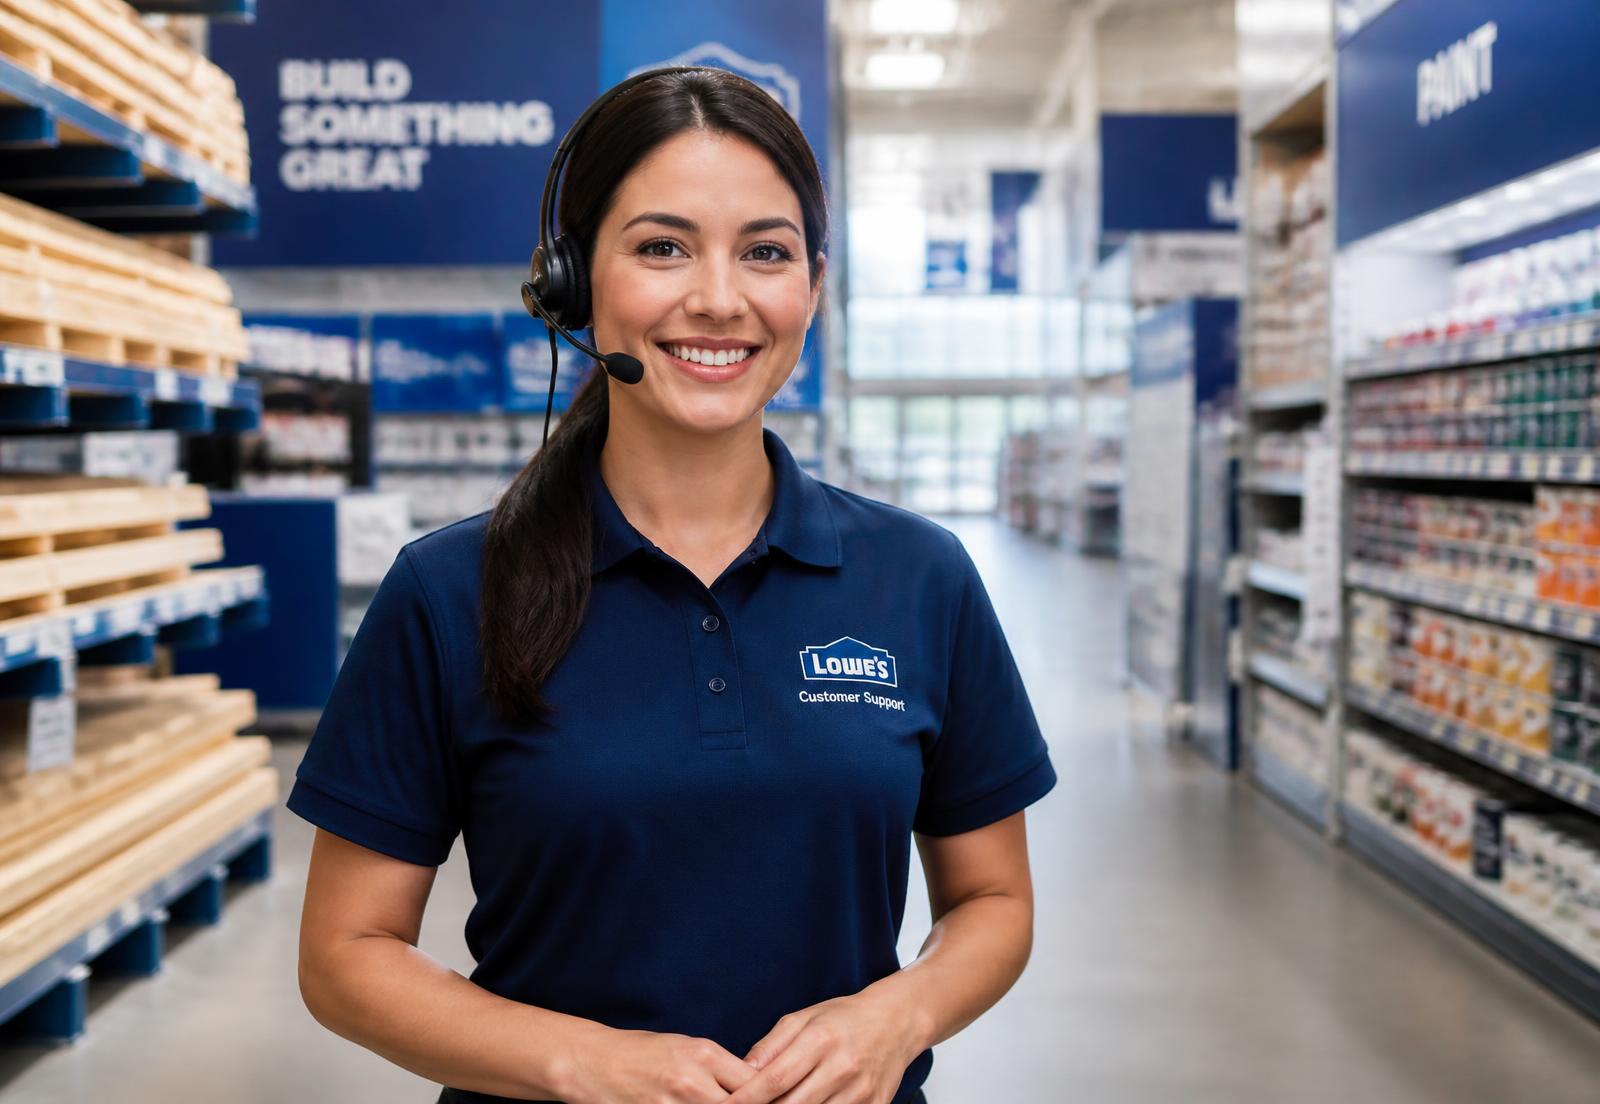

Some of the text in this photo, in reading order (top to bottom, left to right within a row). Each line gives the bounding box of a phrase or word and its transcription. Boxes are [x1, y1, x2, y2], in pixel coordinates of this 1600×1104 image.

[279, 61, 411, 99] BUILD
[1416, 21, 1498, 126] PAINT
[279, 102, 554, 145] SOMETHING
[279, 149, 427, 190] GREAT
[799, 691, 905, 711] Customer Support
